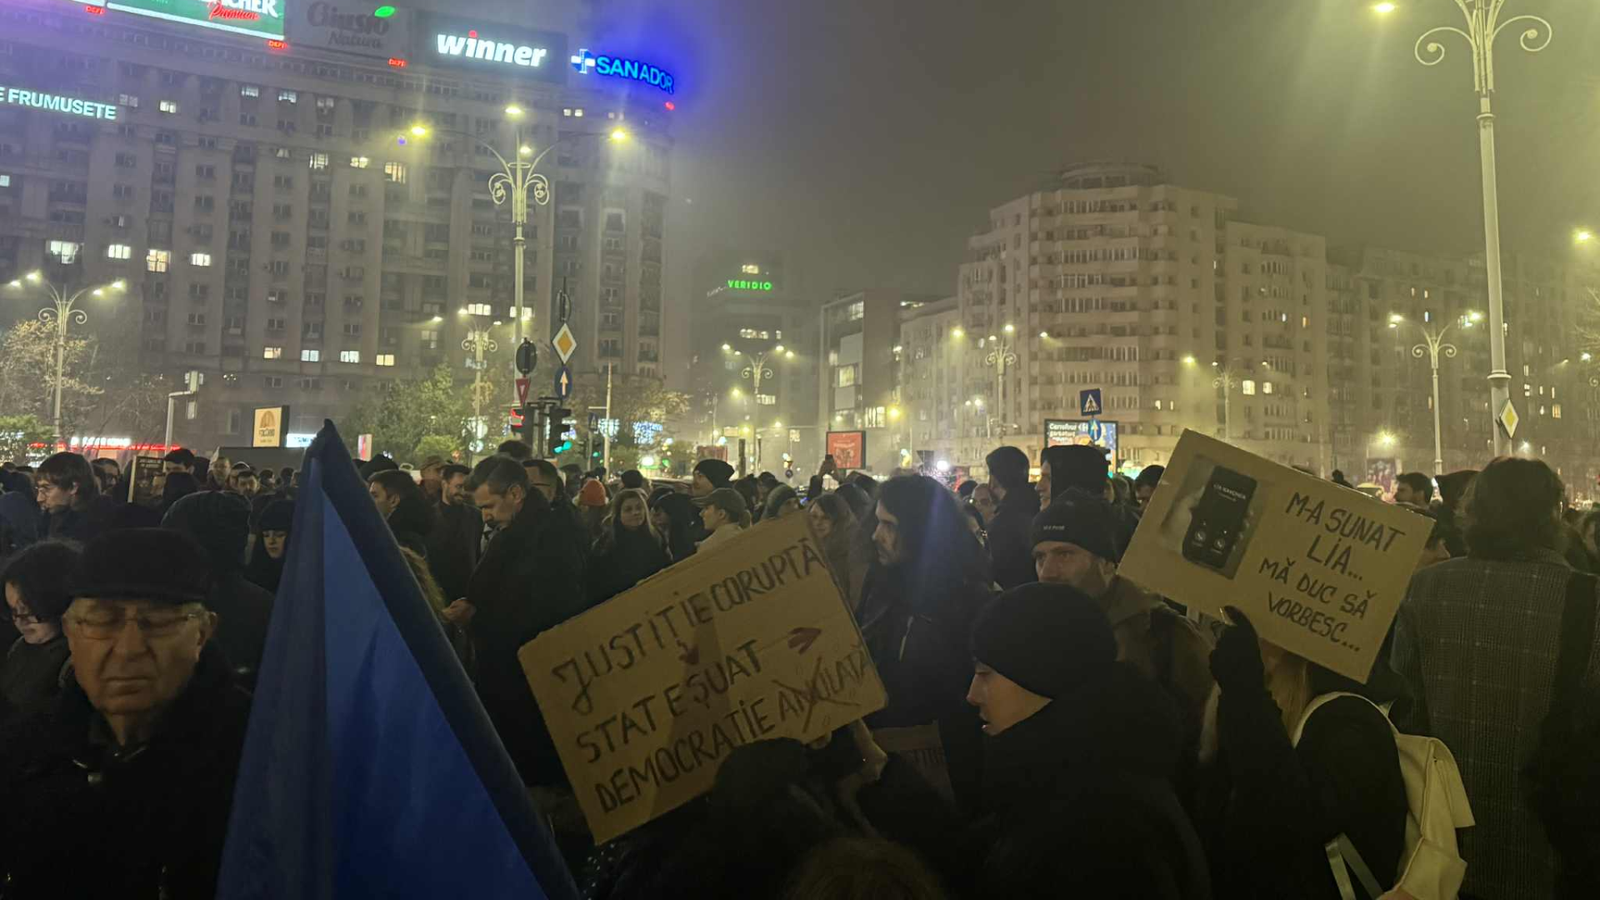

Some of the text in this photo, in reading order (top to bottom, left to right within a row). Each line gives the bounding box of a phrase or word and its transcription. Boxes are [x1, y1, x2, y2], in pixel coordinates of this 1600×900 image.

[209, 2, 260, 20] Premium
[328, 31, 384, 49] Natura
[437, 30, 547, 67] winner
[596, 56, 675, 94] SANADOR
[8, 88, 116, 120] FRUMUSETE
[728, 279, 772, 291] VERIDIO
[1285, 492, 1406, 552] M-A SUNAT
[1258, 557, 1377, 620] MĂ DUC SĂ
[1268, 591, 1360, 652] VORBESC...
[576, 639, 762, 763] STAT EȘUAT
